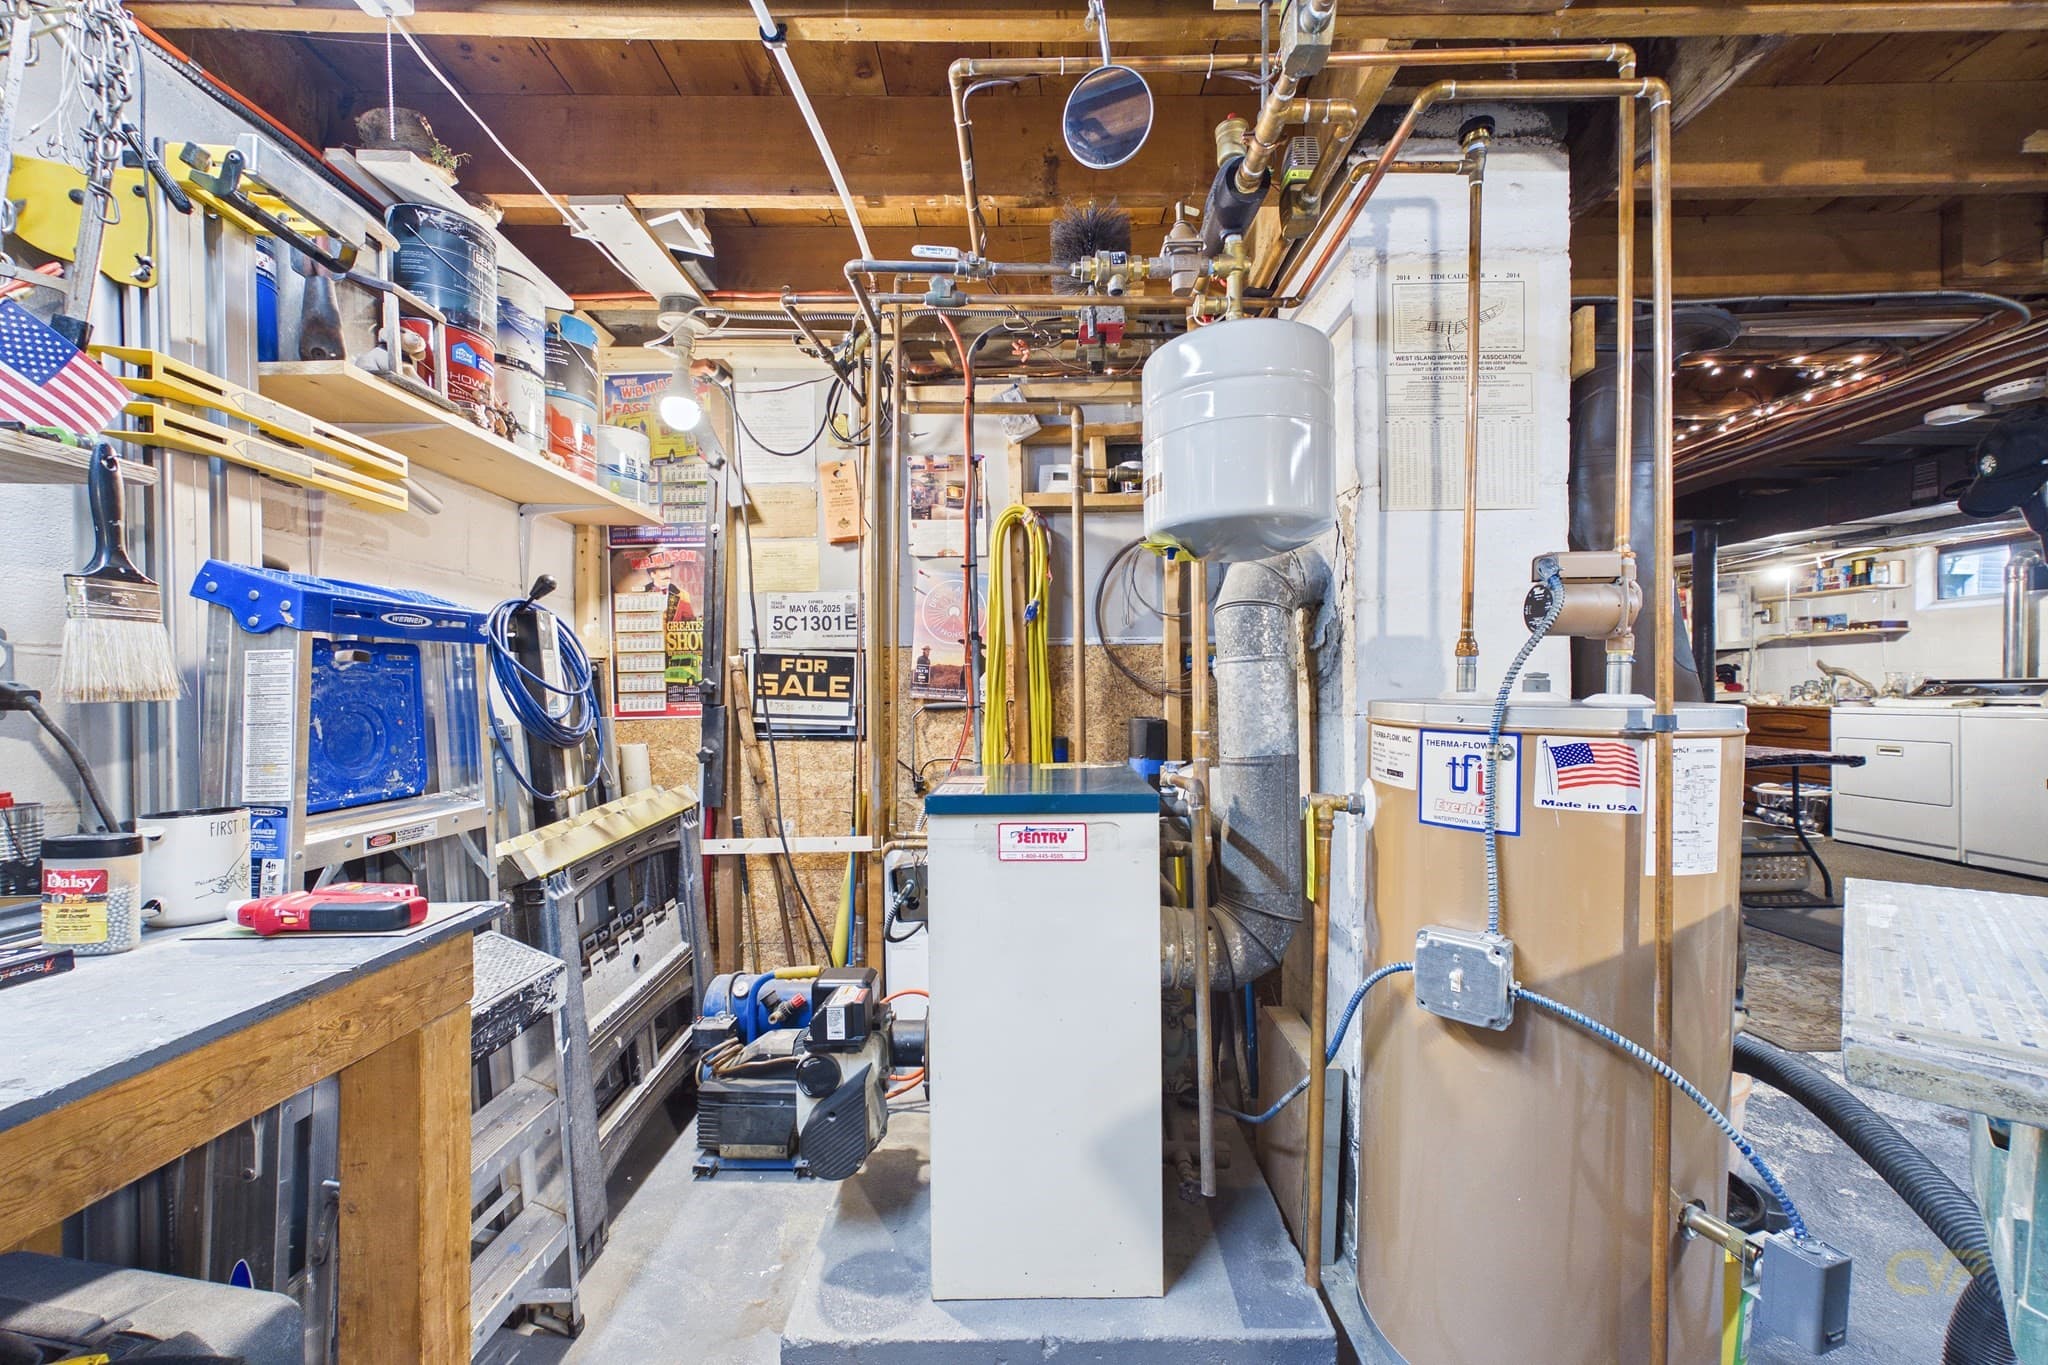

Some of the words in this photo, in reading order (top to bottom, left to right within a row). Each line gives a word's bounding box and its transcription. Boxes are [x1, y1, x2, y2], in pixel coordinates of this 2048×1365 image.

[613, 402, 650, 414] FAST
[650, 550, 696, 564] MASON
[790, 605, 807, 613] MAY
[809, 605, 820, 615] 06,
[823, 605, 841, 613] 2025
[391, 615, 425, 625] WERNER
[667, 632, 703, 651] SHO
[781, 658, 828, 673] FOR
[757, 673, 850, 698] SALE
[1434, 798, 1487, 817] Everho
[1541, 799, 1582, 809] Made
[1588, 802, 1600, 810] in
[1607, 803, 1638, 812] USA
[210, 819, 238, 837] FIRST
[1017, 832, 1068, 844] SENTRY
[47, 873, 101, 893] Daisy
